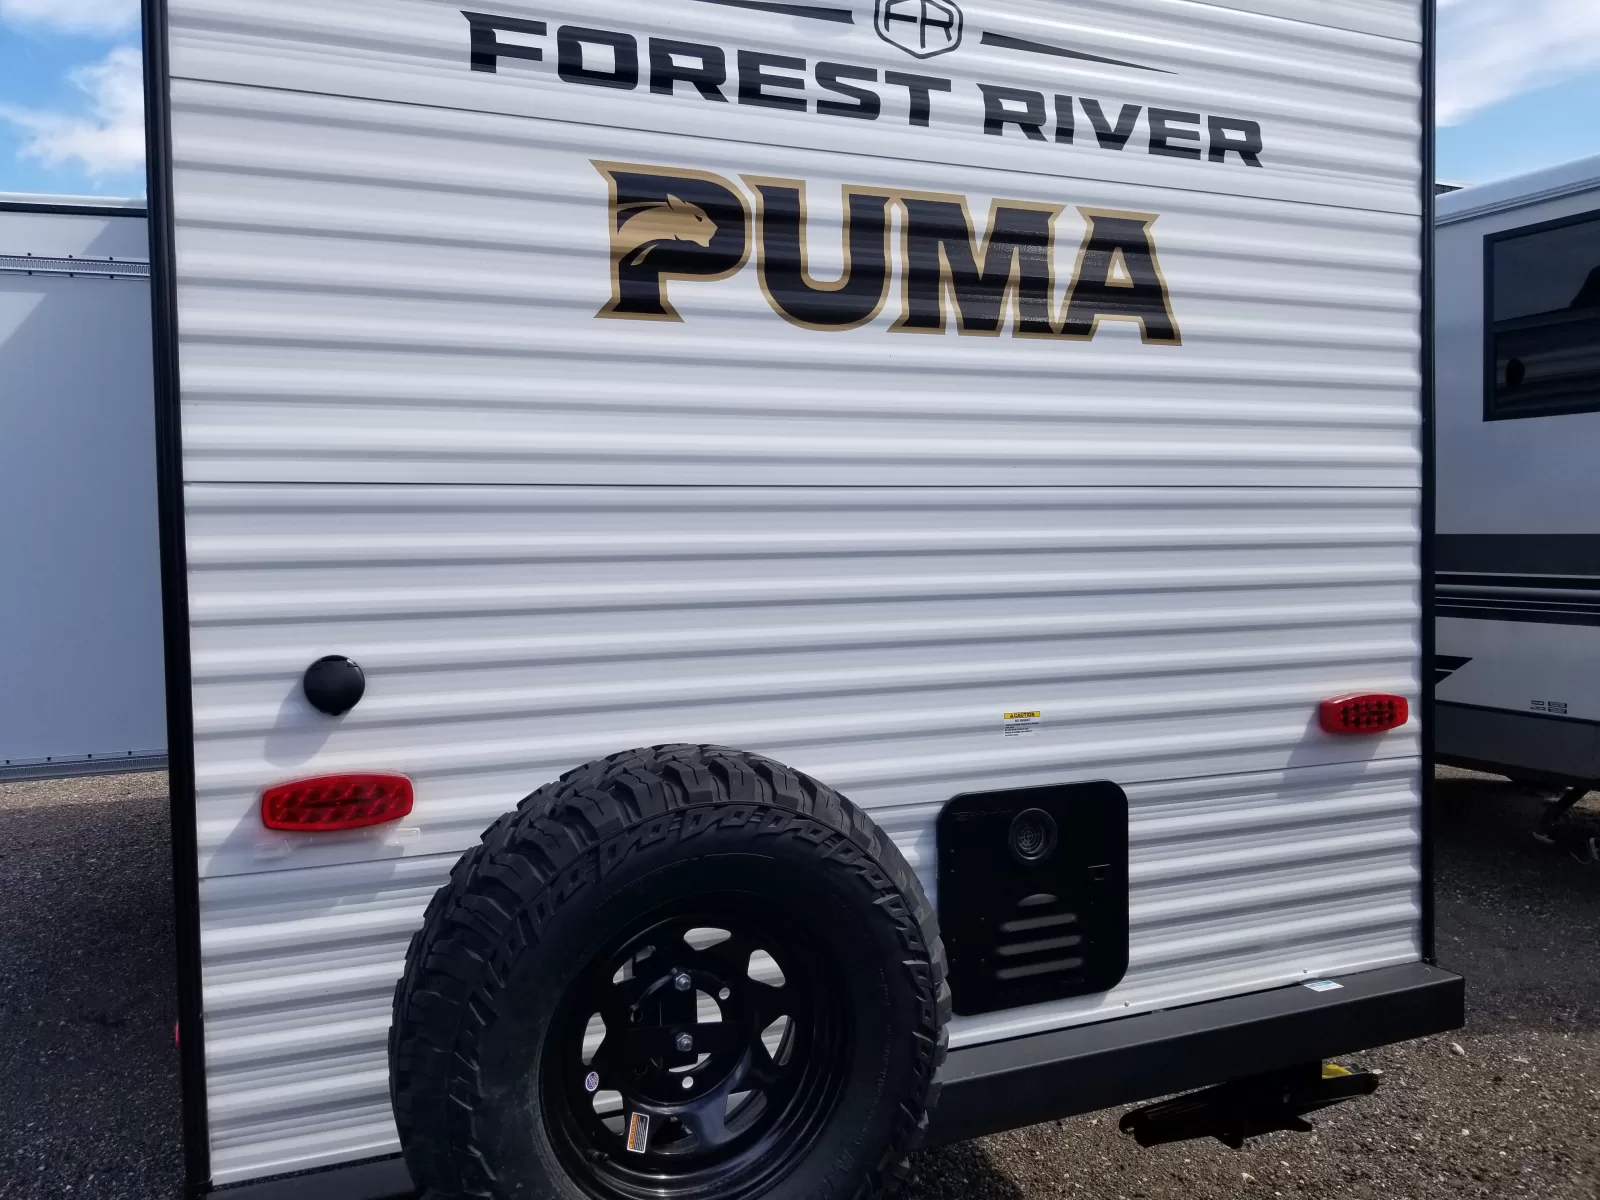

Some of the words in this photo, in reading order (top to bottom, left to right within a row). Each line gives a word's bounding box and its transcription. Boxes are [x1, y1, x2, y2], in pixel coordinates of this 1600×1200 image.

[461, 10, 951, 127] FOREST
[976, 83, 1264, 167] RIVER
[589, 158, 1182, 346] PUMA
